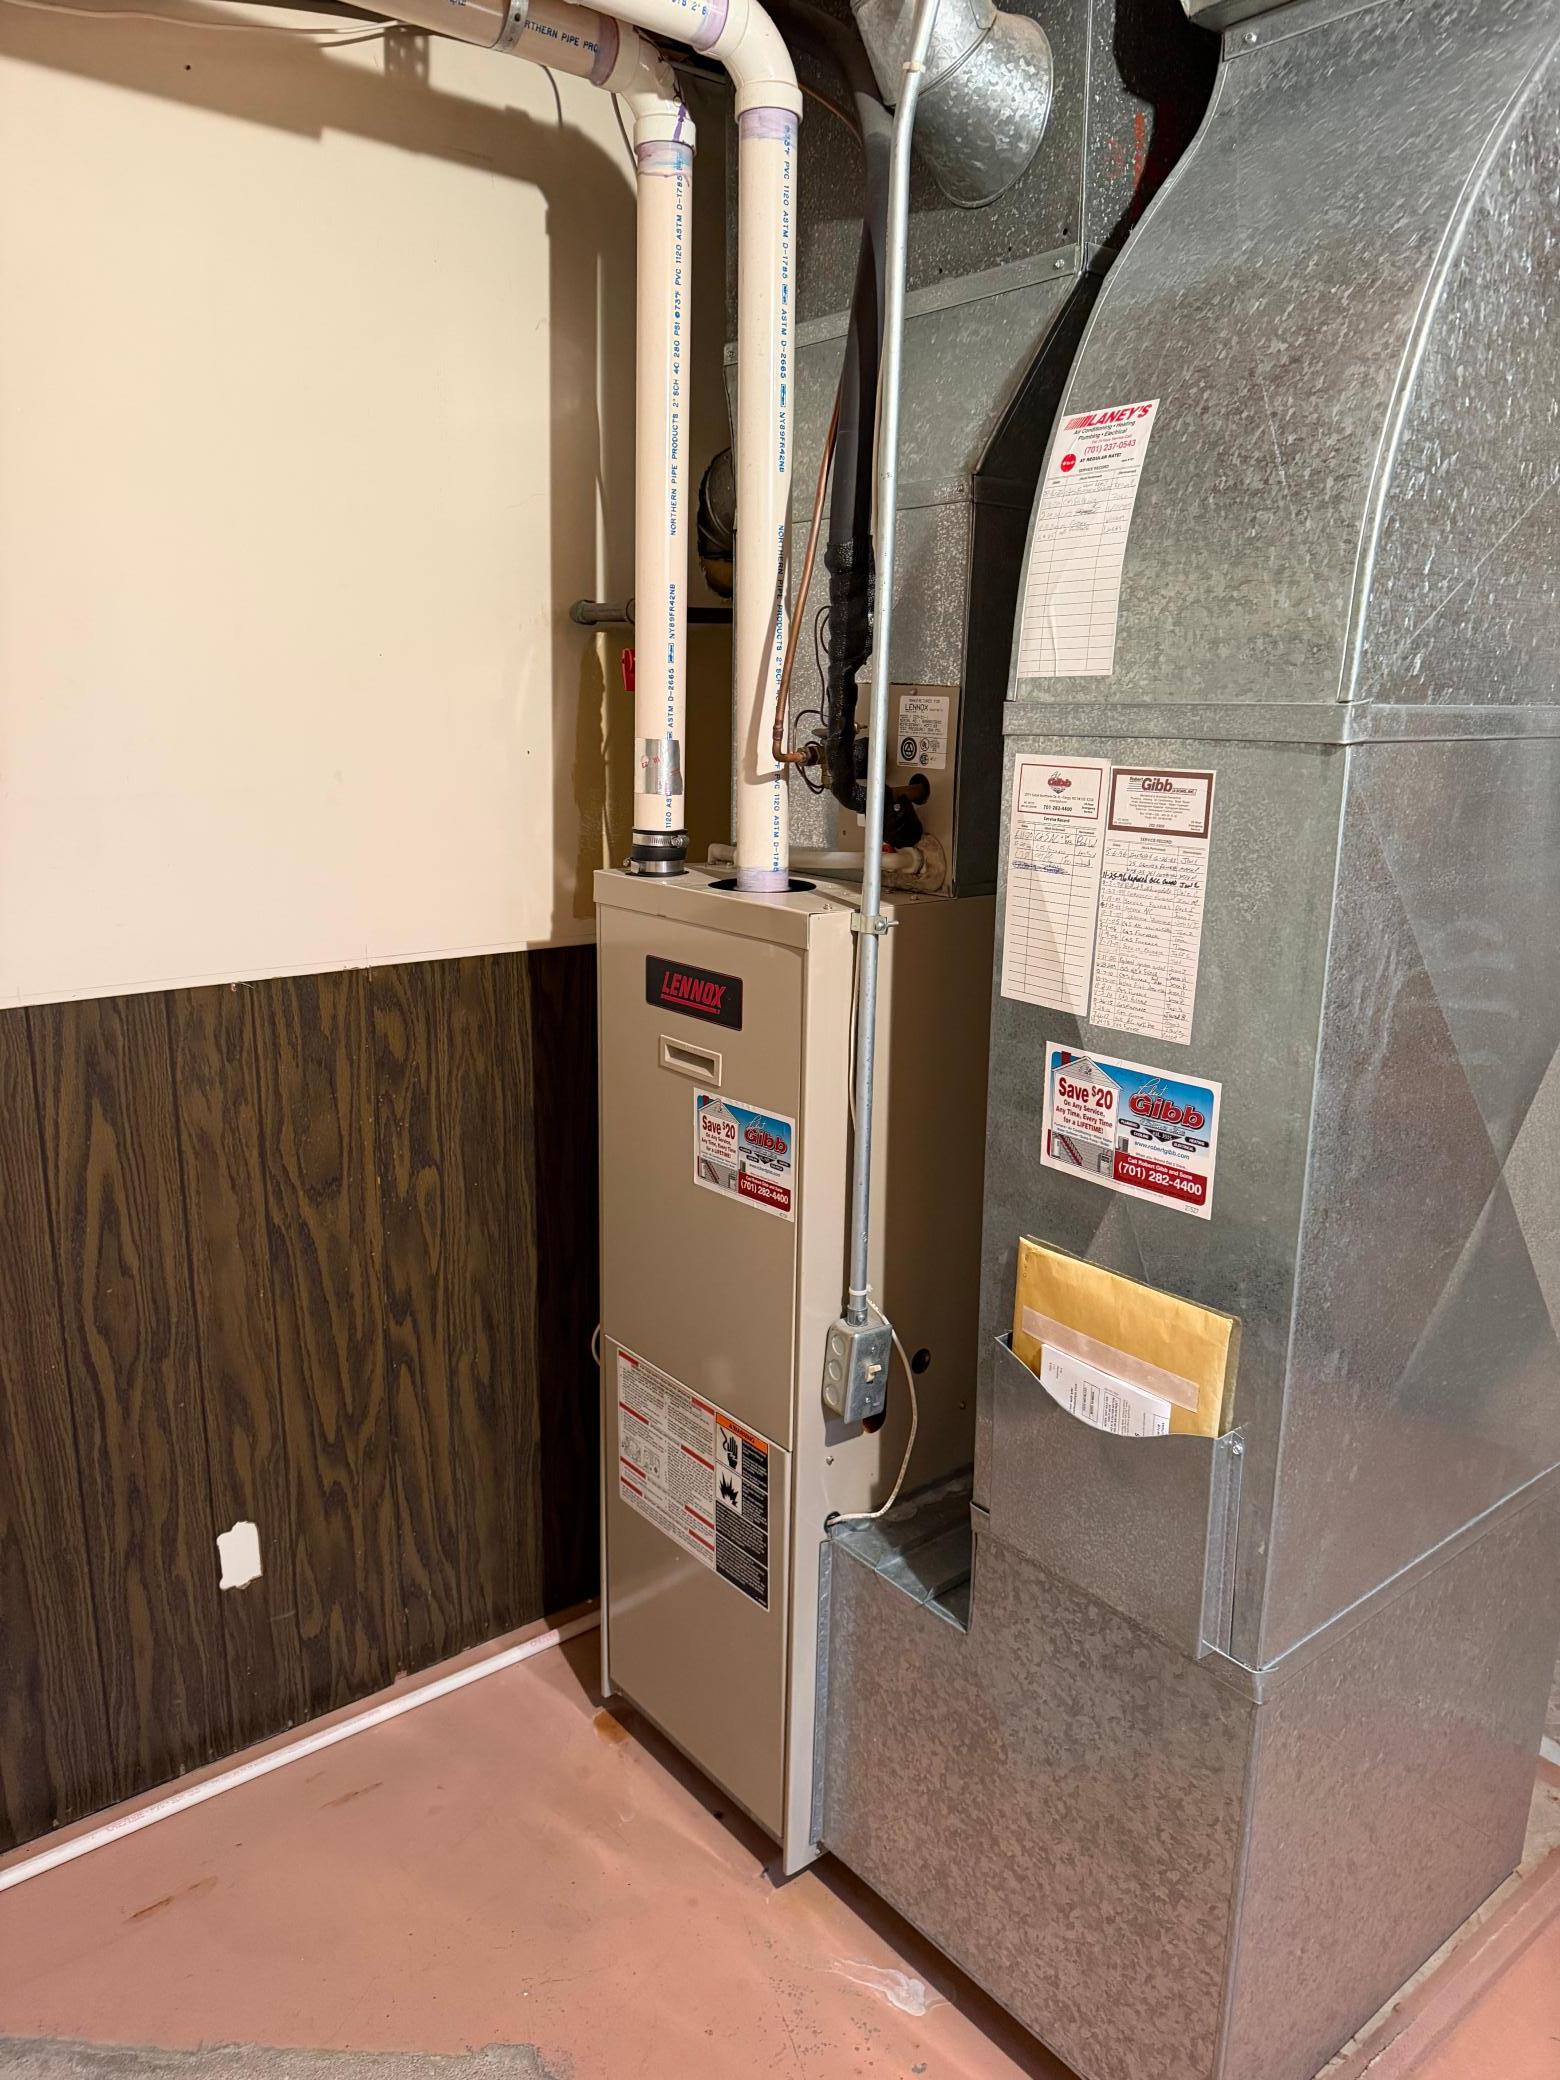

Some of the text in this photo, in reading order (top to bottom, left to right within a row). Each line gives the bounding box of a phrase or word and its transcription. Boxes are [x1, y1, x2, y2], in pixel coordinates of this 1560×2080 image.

[524, 19, 558, 39] RTHERN
[561, 32, 580, 46] PIPE
[783, 160, 791, 180] PVC
[675, 175, 684, 211] D-1785
[782, 185, 790, 207] 1120
[674, 214, 683, 240] ASTM
[781, 210, 790, 238] ASTM
[674, 244, 682, 264] 1120
[780, 242, 789, 279] D-1785
[673, 268, 682, 286] PVC
[779, 308, 788, 336] ASTM
[672, 362, 680, 375] 40
[778, 340, 787, 379] D-2665
[671, 379, 679, 397] SCH
[1082, 424, 1113, 434] Conditioning
[1116, 420, 1136, 428] Heating
[1087, 404, 1152, 427] LANEY'S
[1078, 428, 1128, 440] Plumbing Electrical
[1084, 444, 1102, 456] (701)
[1103, 439, 1136, 452] 237-0543
[669, 464, 677, 484] PIPE
[668, 488, 677, 536] NORTHERN
[776, 525, 785, 575] NORTHERN
[776, 579, 784, 600] PIPE
[775, 604, 784, 651] PRODUCTS
[905, 703, 928, 712] LENNOX
[773, 773, 781, 790] PVC
[1141, 777, 1173, 792] Gibb
[772, 793, 780, 811] 1120
[771, 815, 780, 839] ASTM
[661, 970, 727, 1010] LENNOX
[1058, 1077, 1113, 1110] Save $20
[1056, 1105, 1066, 1115] Any
[1082, 1113, 1098, 1125] Every
[1099, 1119, 1113, 1128] Time
[1072, 1102, 1083, 1111] Any
[1083, 1105, 1106, 1118] Service,
[1129, 1094, 1205, 1130] Gibb
[702, 1115, 736, 1140] Save $20
[1077, 1120, 1104, 1134] LIFETIME!
[744, 1127, 787, 1155] Gibb
[1135, 1141, 1190, 1160] www.robertgibb.com
[1118, 1161, 1146, 1180] (701)
[1148, 1170, 1202, 1196] 282-4400
[1127, 1157, 1137, 1165] Call
[1138, 1160, 1156, 1170] Robert
[1156, 1165, 1168, 1173] Gibb
[1169, 1168, 1179, 1176] and
[1179, 1171, 1193, 1180] Sons
[740, 1178, 757, 1194] (701)
[757, 1185, 789, 1204] 282-4400
